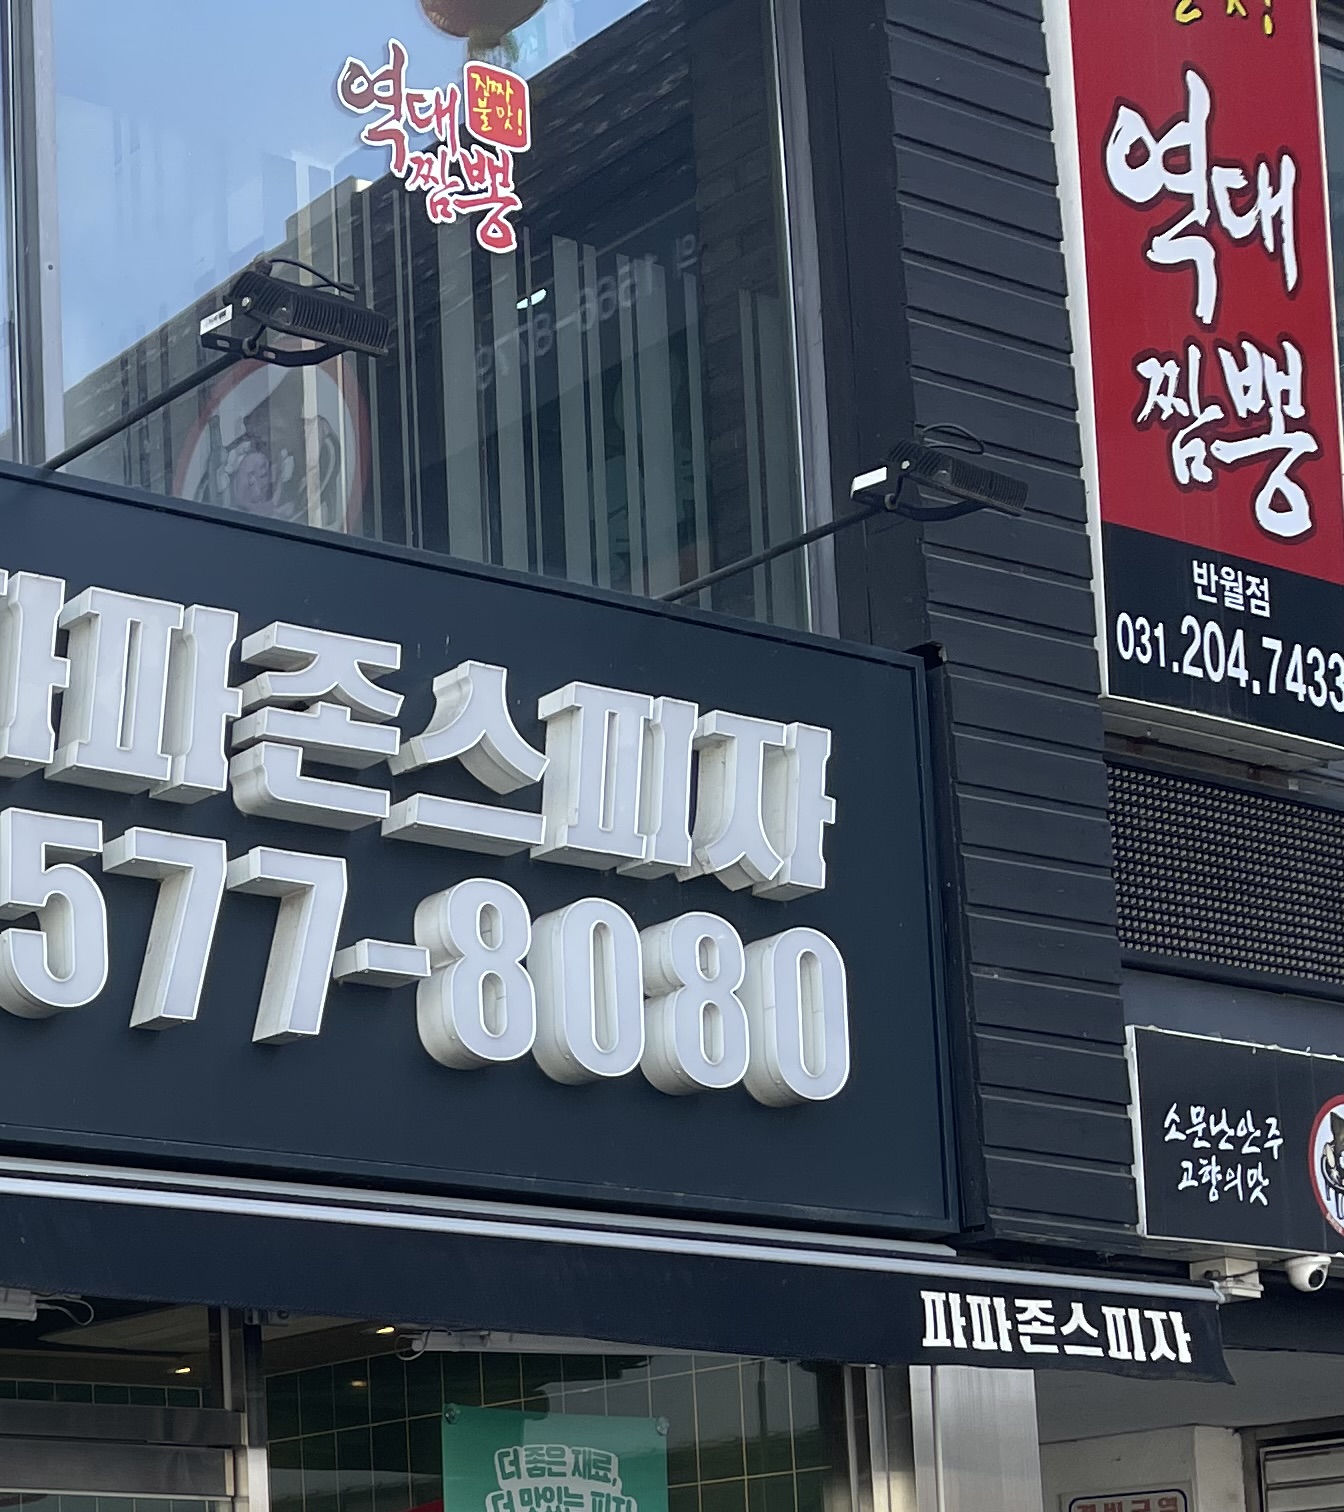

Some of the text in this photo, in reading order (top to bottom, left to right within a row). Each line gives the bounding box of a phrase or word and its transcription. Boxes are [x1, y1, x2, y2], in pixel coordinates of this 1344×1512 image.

[408, 147, 520, 251] 짬뽕
[1105, 69, 1297, 324] 역대
[1136, 340, 1318, 537] 짬뽕
[1191, 559, 1271, 619] 반월점
[1115, 611, 1344, 714] 031.204.7433
[920, 1289, 1193, 1365] 파파존스피자
[497, 1447, 522, 1480] 더
[523, 1446, 567, 1480] 좋은
